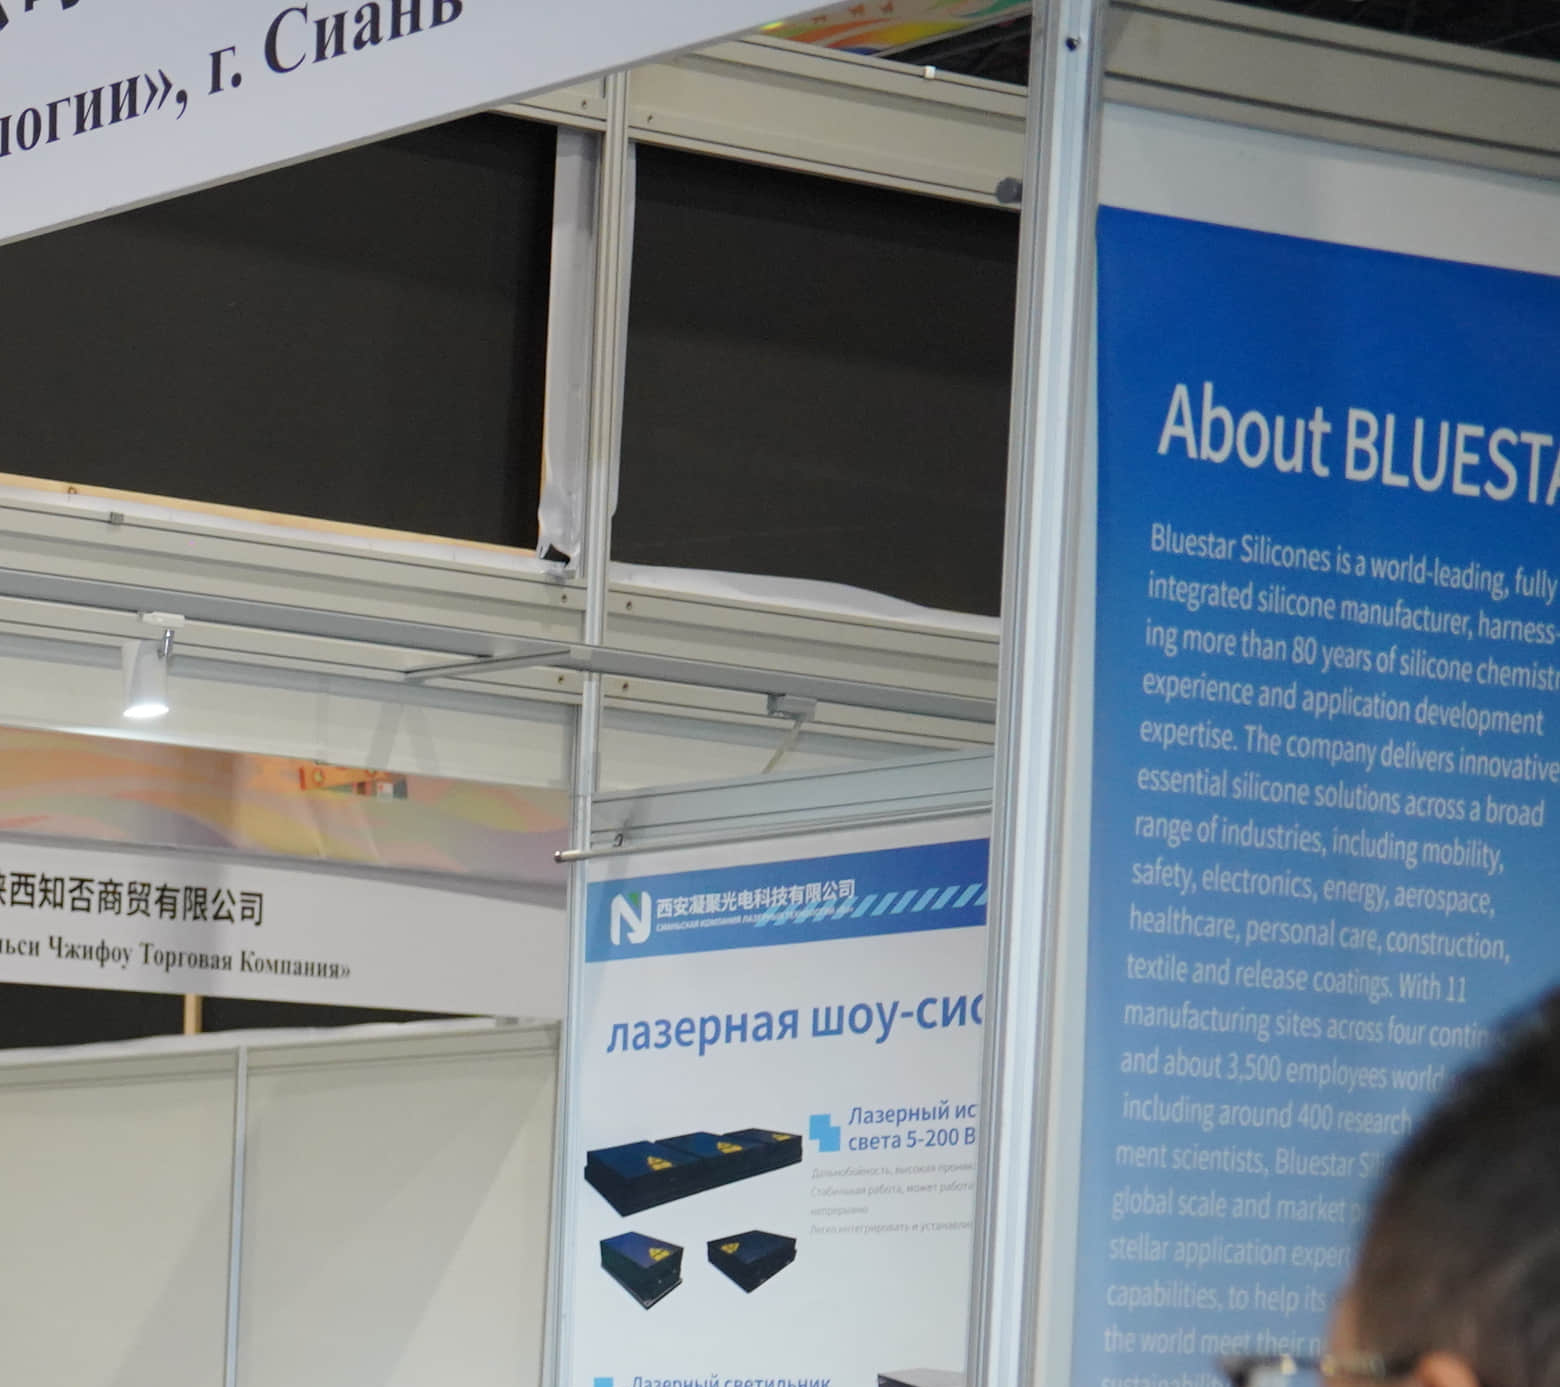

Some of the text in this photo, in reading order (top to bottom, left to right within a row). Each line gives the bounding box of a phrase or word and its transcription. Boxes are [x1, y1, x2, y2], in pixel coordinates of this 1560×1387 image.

[207, 46, 242, 95] г.
[1157, 381, 1330, 478] About
[1150, 523, 1558, 606] Bluestar Silicones is a world-leading, fully
[1148, 570, 1560, 644] integrated silicone manufacturer, harness-
[1145, 618, 1178, 657] ing
[1182, 630, 1237, 656] more
[1241, 629, 1287, 660] than
[1291, 636, 1318, 665] 80
[1321, 645, 1372, 674] years
[1375, 644, 1397, 673] of
[1399, 649, 1473, 682] silicone
[1142, 672, 1544, 736] experience and application development
[1139, 720, 1237, 751] expertise.
[1244, 724, 1281, 756] The
[1285, 735, 1377, 772] company
[1380, 739, 1454, 773] delivers
[1137, 768, 1545, 827] essential silicone solutions across a broad
[1134, 814, 1504, 876] range of industries, including mobility,
[657, 879, 855, 918] 西安凝聚光电科技有限公司
[49, 934, 133, 970] Чжифоу
[139, 941, 232, 972] Торговая
[240, 949, 351, 980] Компания»
[606, 1006, 799, 1057] лазерная
[1120, 1047, 1159, 1074] and
[1162, 1047, 1222, 1079] about
[1225, 1052, 1282, 1082] 3,500
[1285, 1056, 1387, 1093] employees
[848, 1101, 950, 1126] Лазерный
[848, 1130, 901, 1152] света
[905, 1128, 961, 1149] 5-200
